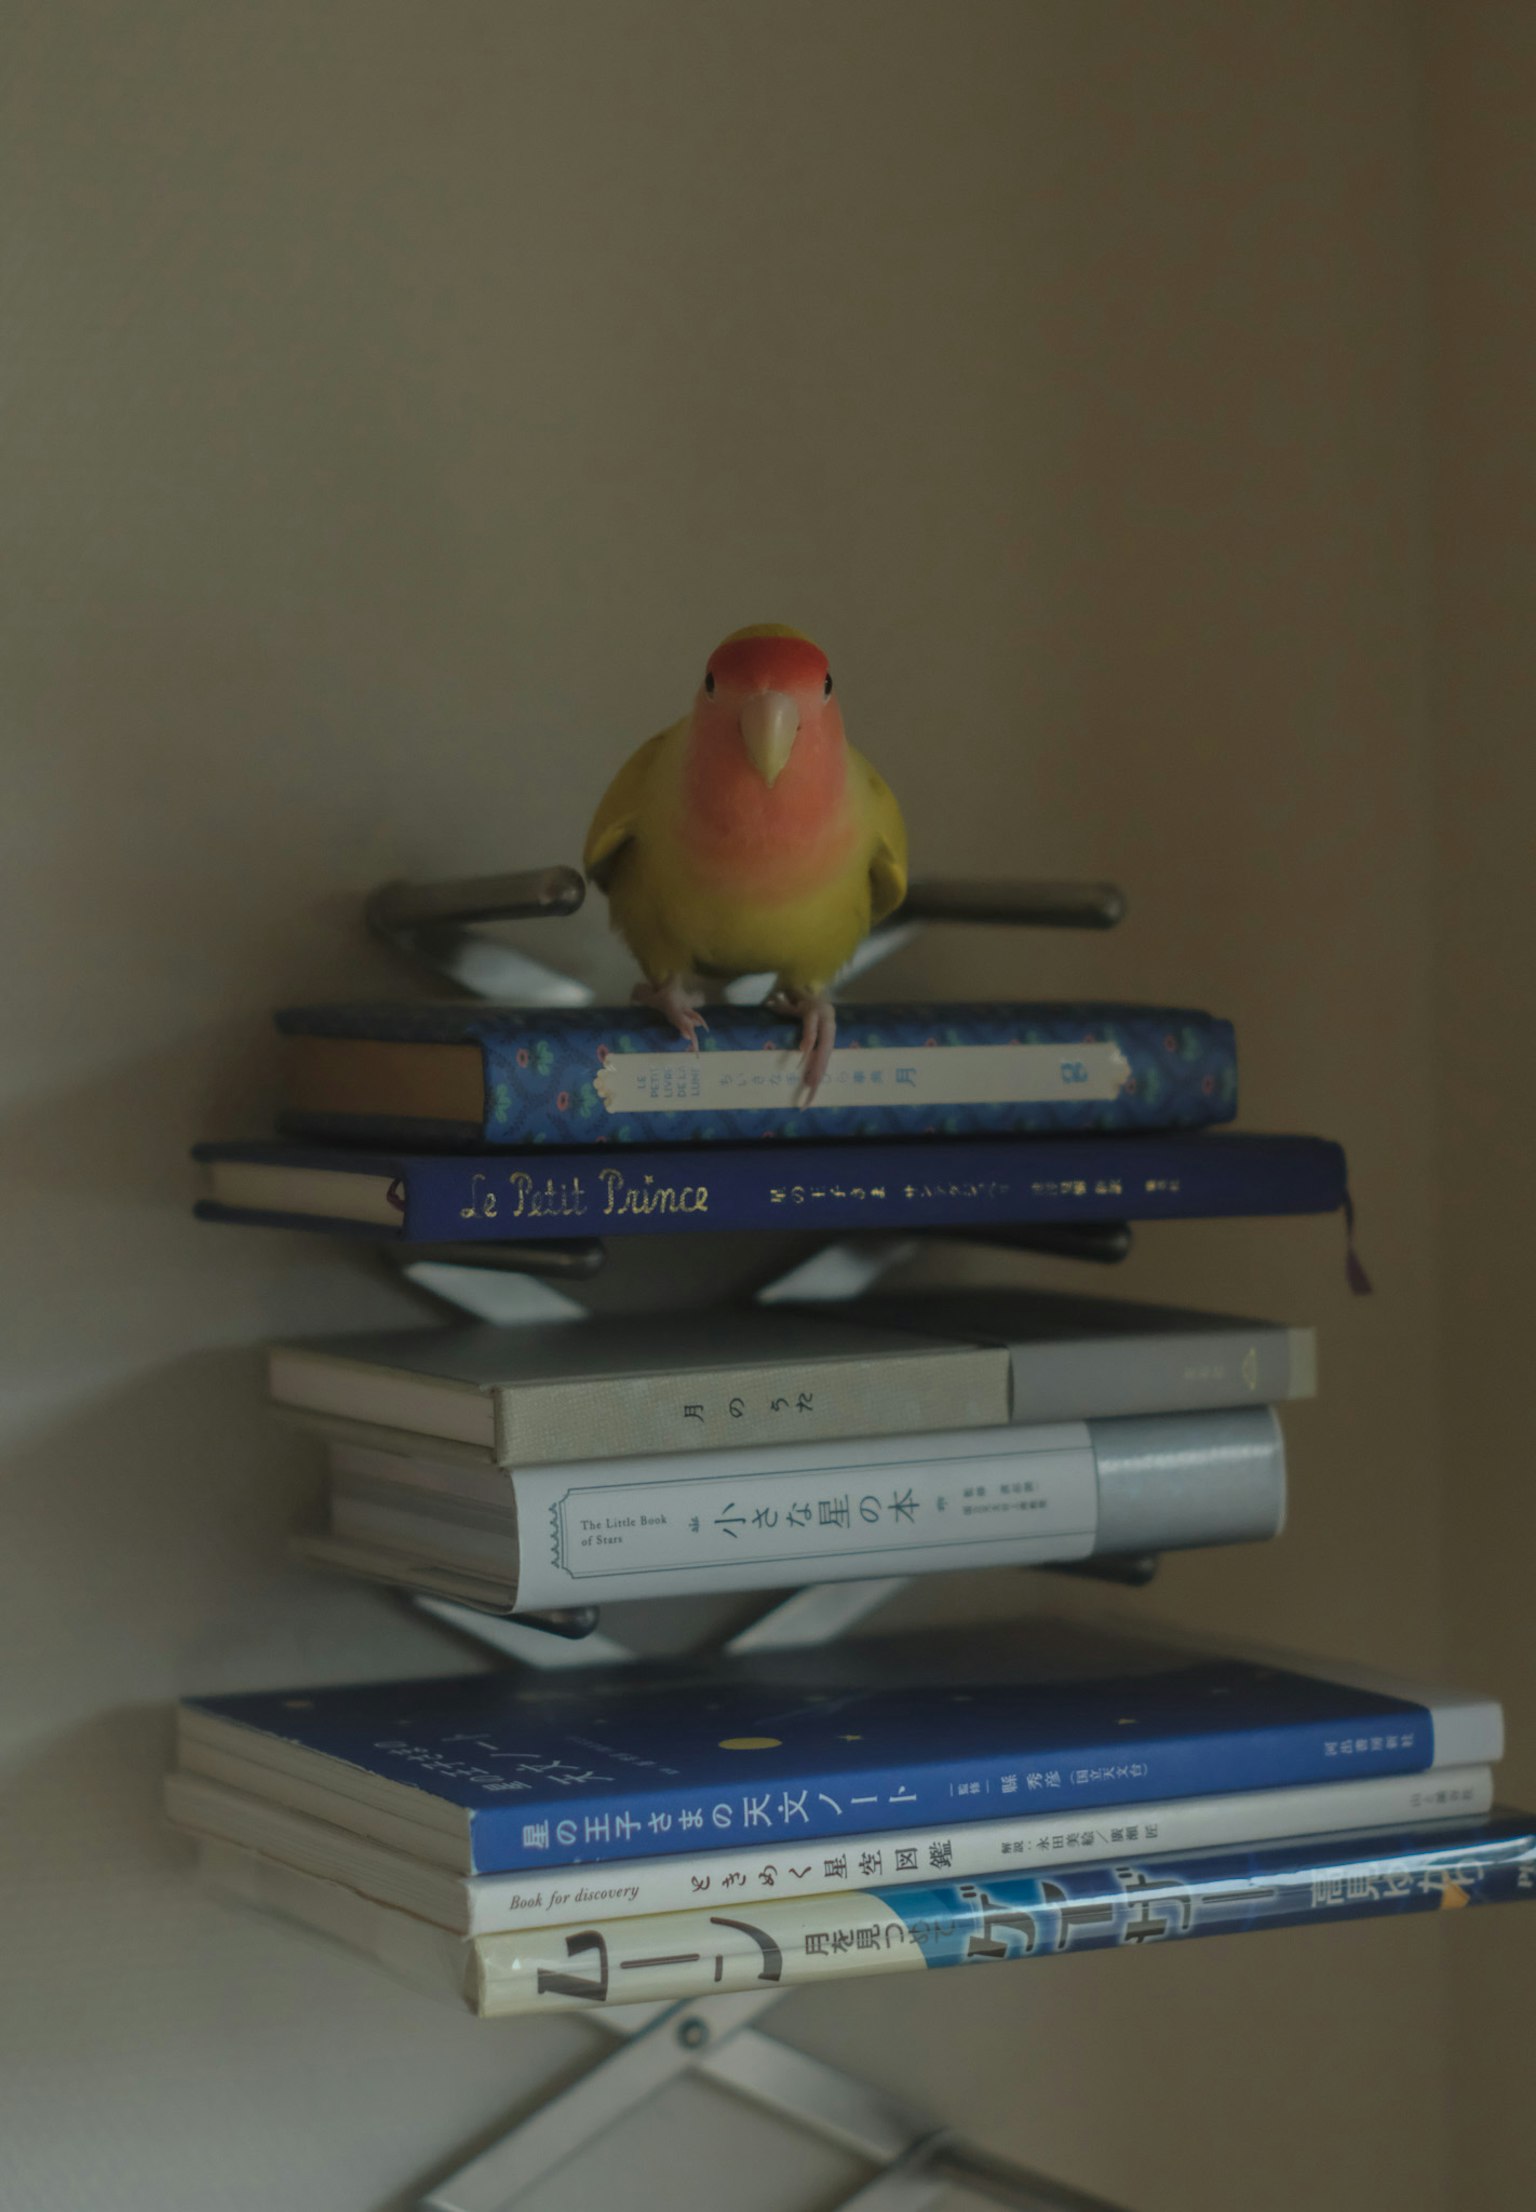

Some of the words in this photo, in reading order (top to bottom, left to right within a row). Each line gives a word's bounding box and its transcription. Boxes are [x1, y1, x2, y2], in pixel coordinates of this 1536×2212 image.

[896, 1067, 917, 1088] 月
[459, 1173, 498, 1218] Le
[509, 1171, 587, 1217] Petit
[598, 1168, 709, 1215] Prince
[684, 1392, 813, 1423] 月のうた
[580, 1519, 602, 1531] The
[606, 1517, 636, 1529] Little
[640, 1514, 668, 1526] Book
[714, 1487, 920, 1539] 小さな星の本
[581, 1535, 594, 1547] of
[596, 1534, 623, 1546] Stars
[521, 1784, 918, 1850] 星の王子さまの天文ノート
[691, 1839, 953, 1892] ときめく星空図鑑
[509, 1893, 543, 1911] Book
[546, 1890, 570, 1910] for
[574, 1882, 640, 1904] discovery
[537, 1915, 783, 2002] ムーン
[804, 1916, 956, 1958] 月を見つめて
[960, 1866, 1277, 1959] ゲイザー
